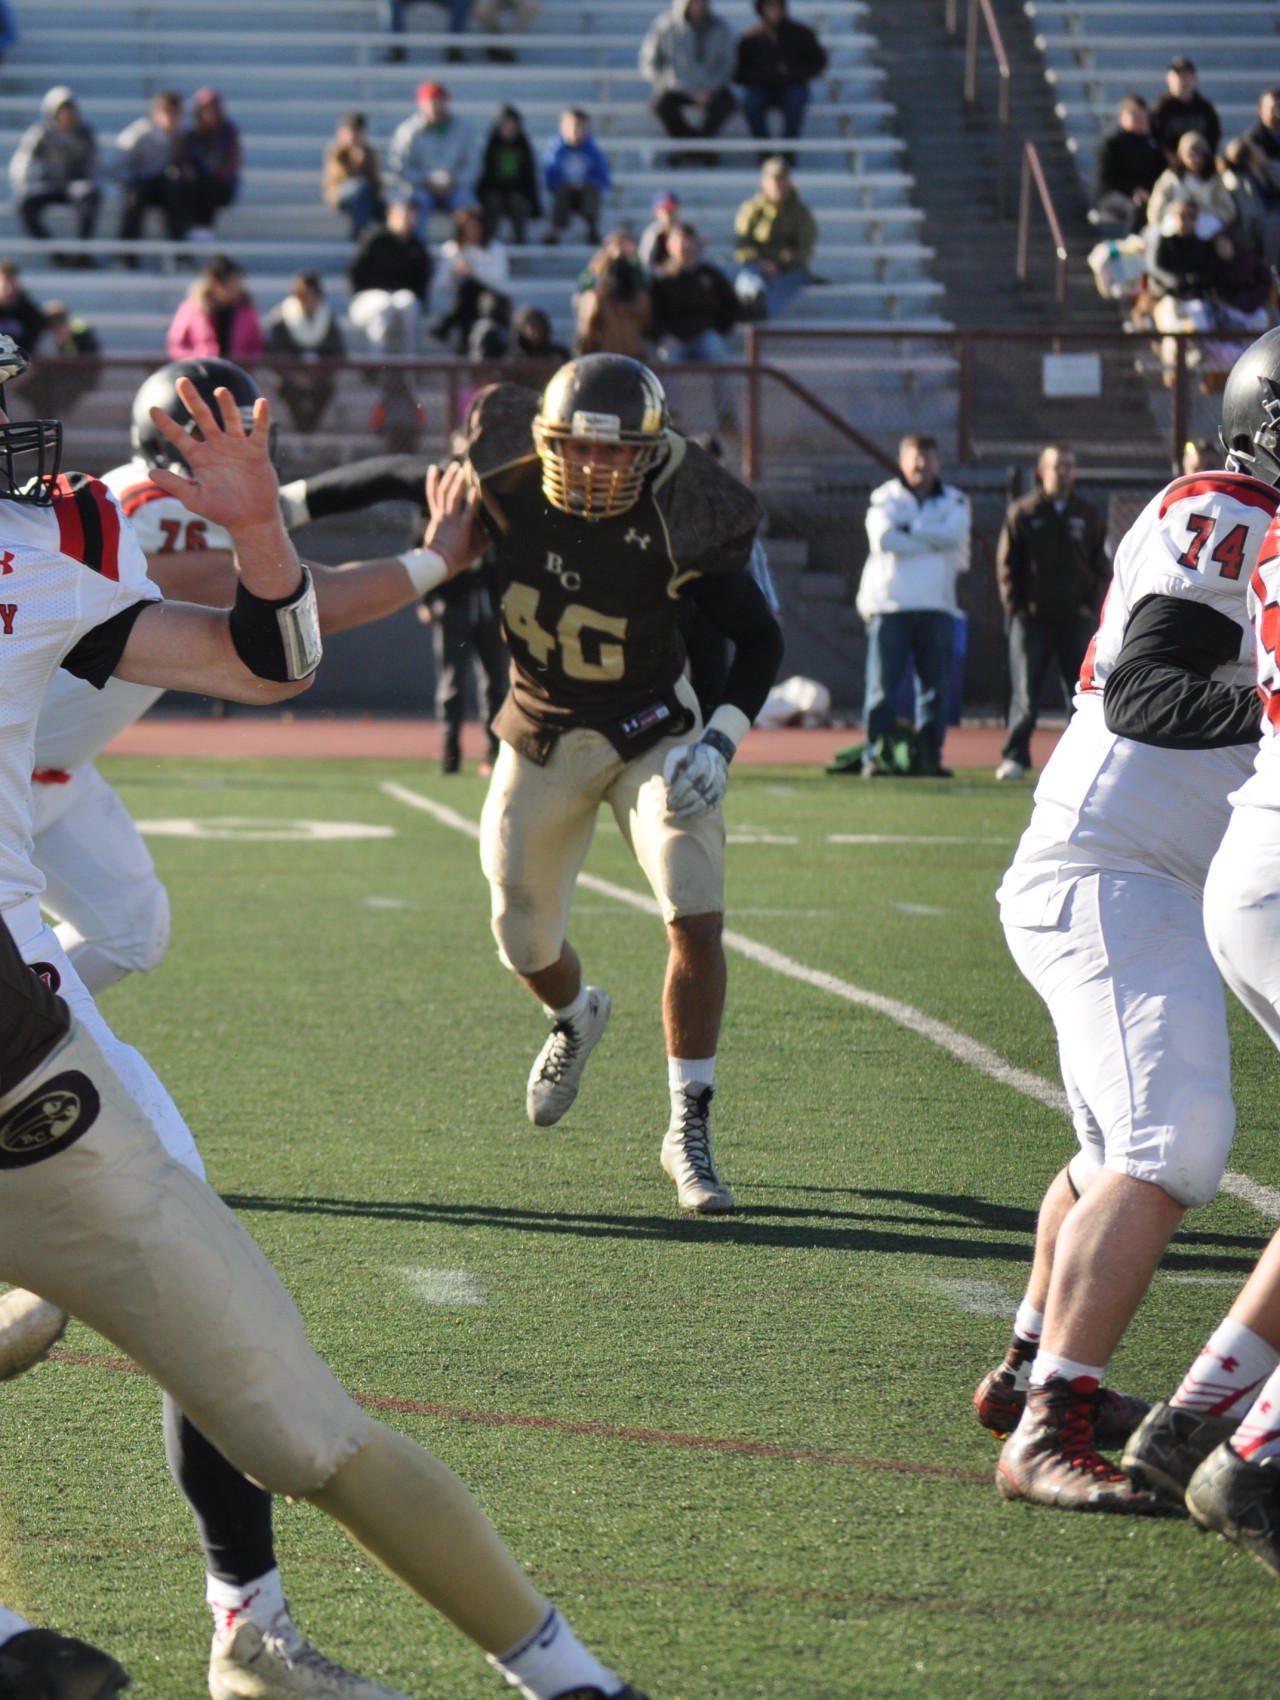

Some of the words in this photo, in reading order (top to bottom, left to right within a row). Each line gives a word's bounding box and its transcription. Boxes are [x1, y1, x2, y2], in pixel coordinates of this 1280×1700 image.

[159, 519, 208, 553] 76
[1177, 513, 1250, 581] 74
[545, 551, 582, 591] BC
